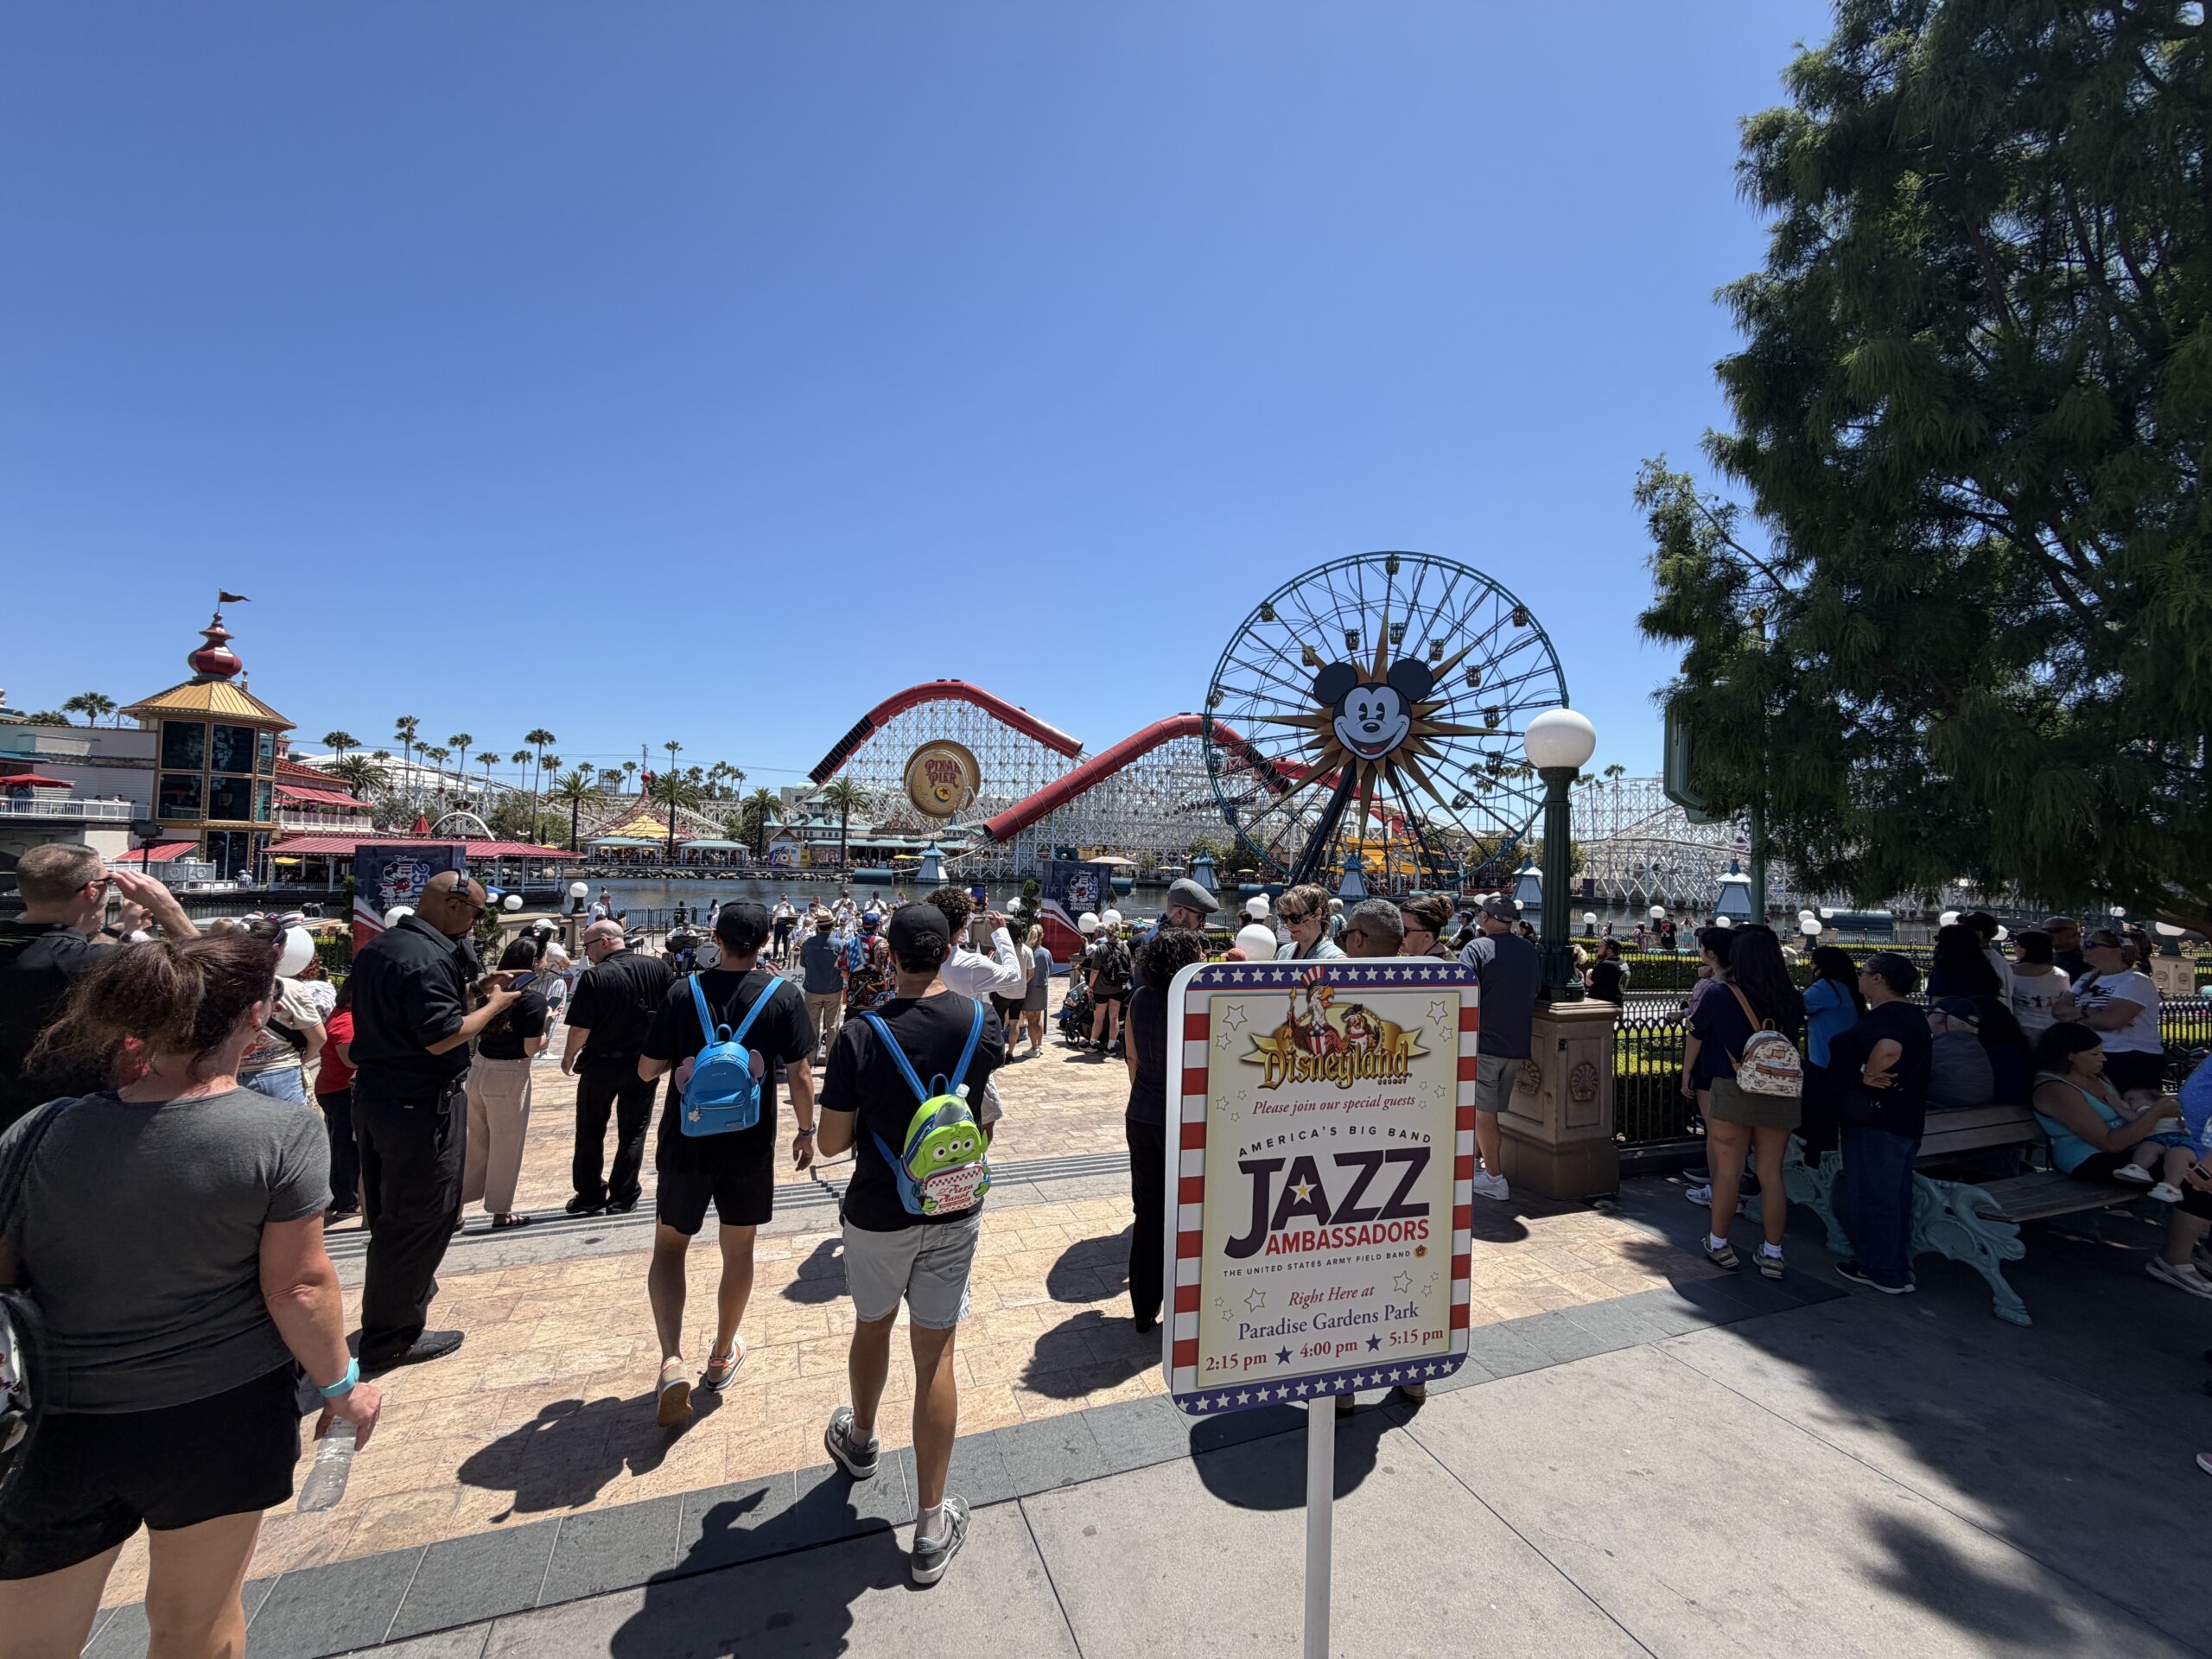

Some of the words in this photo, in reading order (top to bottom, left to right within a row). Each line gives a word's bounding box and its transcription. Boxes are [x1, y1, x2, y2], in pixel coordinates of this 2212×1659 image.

[928, 772, 959, 789] PIER
[394, 855, 418, 864] Disney
[1088, 876, 1098, 901] 250
[1257, 1039, 1409, 1090] Disneyland
[1252, 1101, 1288, 1115] Please
[1290, 1100, 1316, 1116] join
[1319, 1101, 1340, 1110] our
[1343, 1094, 1382, 1113] special
[1383, 1095, 1416, 1111] guests
[1238, 1126, 1338, 1157] AMERICA'S
[1349, 1126, 1376, 1135] BIG
[1388, 1128, 1431, 1144] BAND
[947, 1184, 974, 1193] Pizza
[1224, 1147, 1431, 1259] JAZZ
[1265, 1219, 1430, 1256] AMBASSADORS
[1223, 1269, 1242, 1278] THE
[1246, 1265, 1283, 1275] UNITED
[1287, 1260, 1322, 1271] STATES
[1325, 1256, 1351, 1267] ARMY
[1356, 1253, 1382, 1263] FIELD
[1386, 1250, 1411, 1260] BAND
[1287, 1290, 1324, 1309] Right
[1326, 1286, 1357, 1303] Here
[1360, 1286, 1376, 1298] at
[1238, 1316, 1307, 1341] Paradise
[1313, 1307, 1379, 1331] Gardens
[1383, 1301, 1420, 1322] Park
[1205, 1353, 1239, 1371] 2:15
[1242, 1353, 1268, 1371] pm
[1300, 1341, 1332, 1358] 4:00
[1335, 1342, 1358, 1358] pm
[1389, 1329, 1419, 1346] 5:15
[1421, 1329, 1444, 1346] pm
